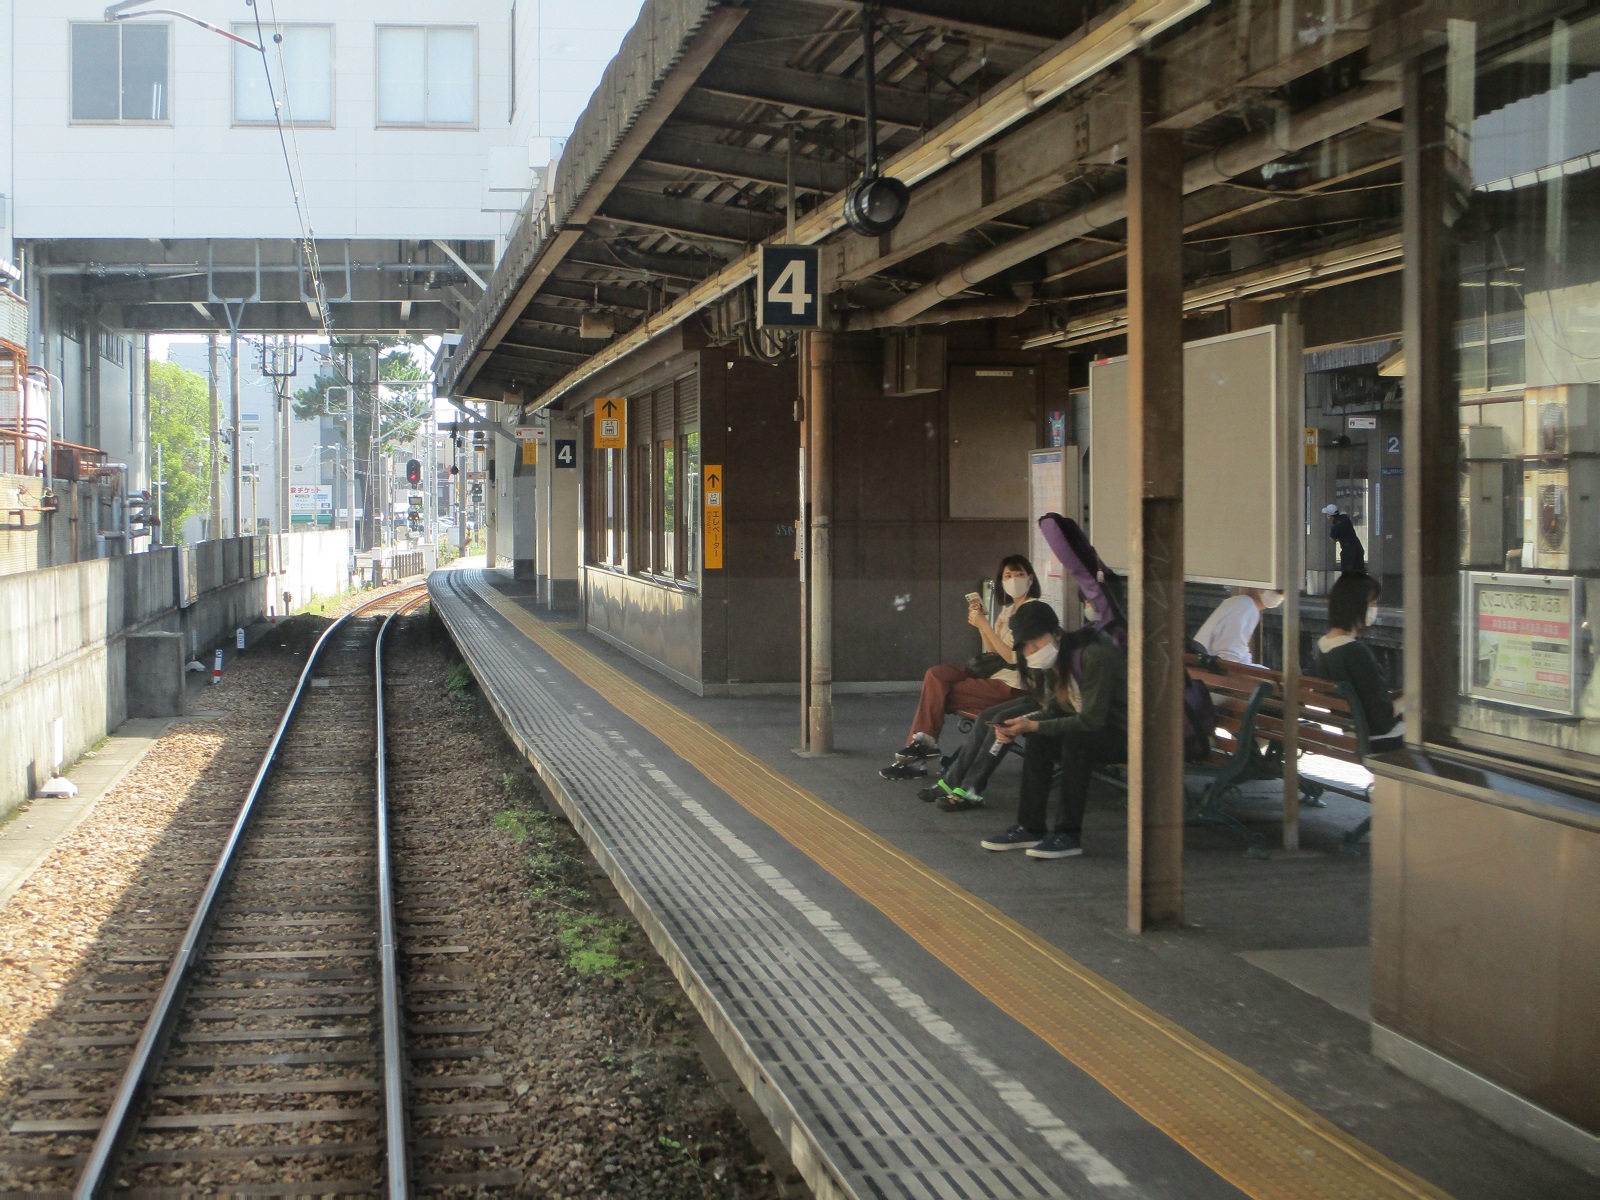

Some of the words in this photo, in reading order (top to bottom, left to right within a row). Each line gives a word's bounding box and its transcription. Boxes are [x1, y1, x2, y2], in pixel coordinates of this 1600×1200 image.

[767, 259, 812, 315] 4
[558, 445, 573, 464] 4
[1388, 436, 1400, 453] 2
[712, 510, 720, 557] エレベーター
